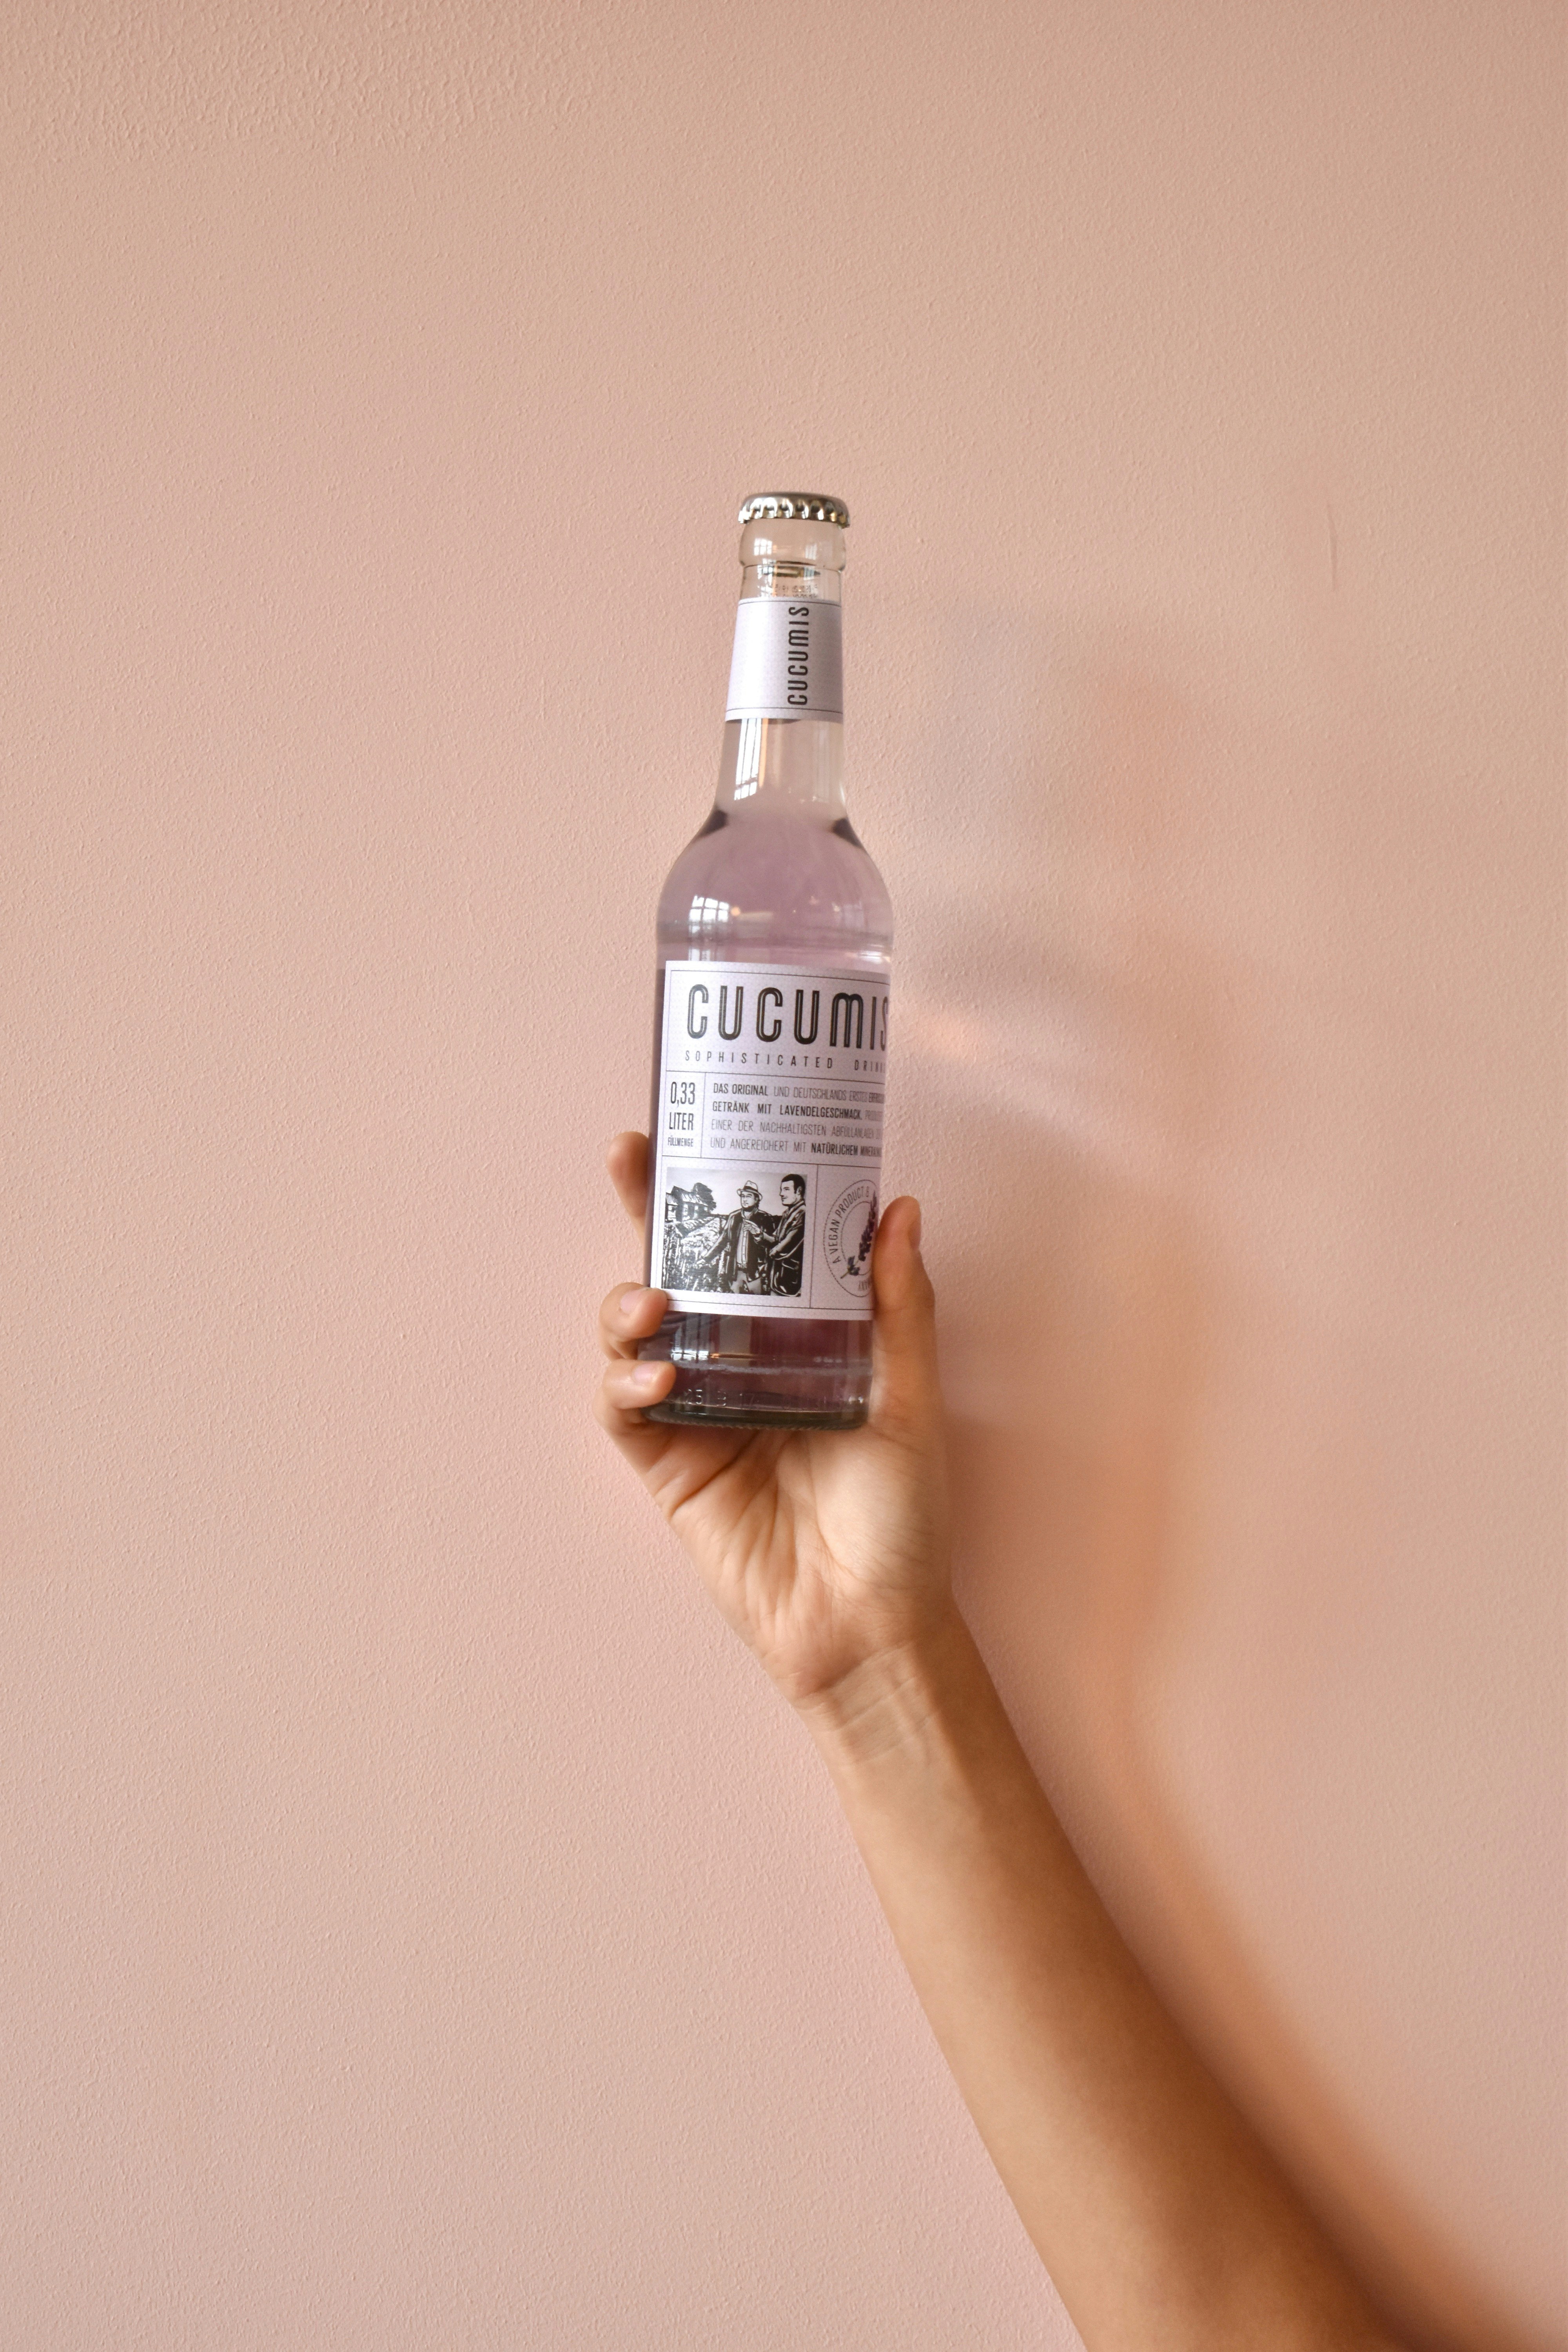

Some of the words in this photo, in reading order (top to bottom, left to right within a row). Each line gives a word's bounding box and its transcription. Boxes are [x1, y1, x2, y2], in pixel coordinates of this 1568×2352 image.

[788, 606, 809, 706] CUCUMIS
[687, 984, 888, 1051] CUCUMIS
[685, 1050, 833, 1069] SOPHISTICATED
[670, 1082, 695, 1108] 0,33
[713, 1083, 729, 1094] DAS
[732, 1084, 768, 1096] ORIGINAL
[774, 1086, 789, 1097] UND
[793, 1087, 847, 1101] DEUTSCHLANDS
[712, 1100, 750, 1113] GETRÄNK
[757, 1103, 772, 1114] MIT
[669, 1112, 694, 1131] LITER
[711, 1119, 732, 1131] EINER
[738, 1120, 754, 1132] DER
[759, 1122, 826, 1136] NACHHALTIGSTEN
[668, 1135, 693, 1147] FÜLLMENGE
[710, 1137, 725, 1148] UND
[730, 1138, 788, 1151] ANGEREICHERT
[793, 1141, 807, 1152] MIT
[811, 1142, 858, 1156] NATÜRLICHEM
[835, 1186, 864, 1218] PRODUCT
[828, 1219, 840, 1255] VEGAN
[832, 1256, 842, 1264] A
